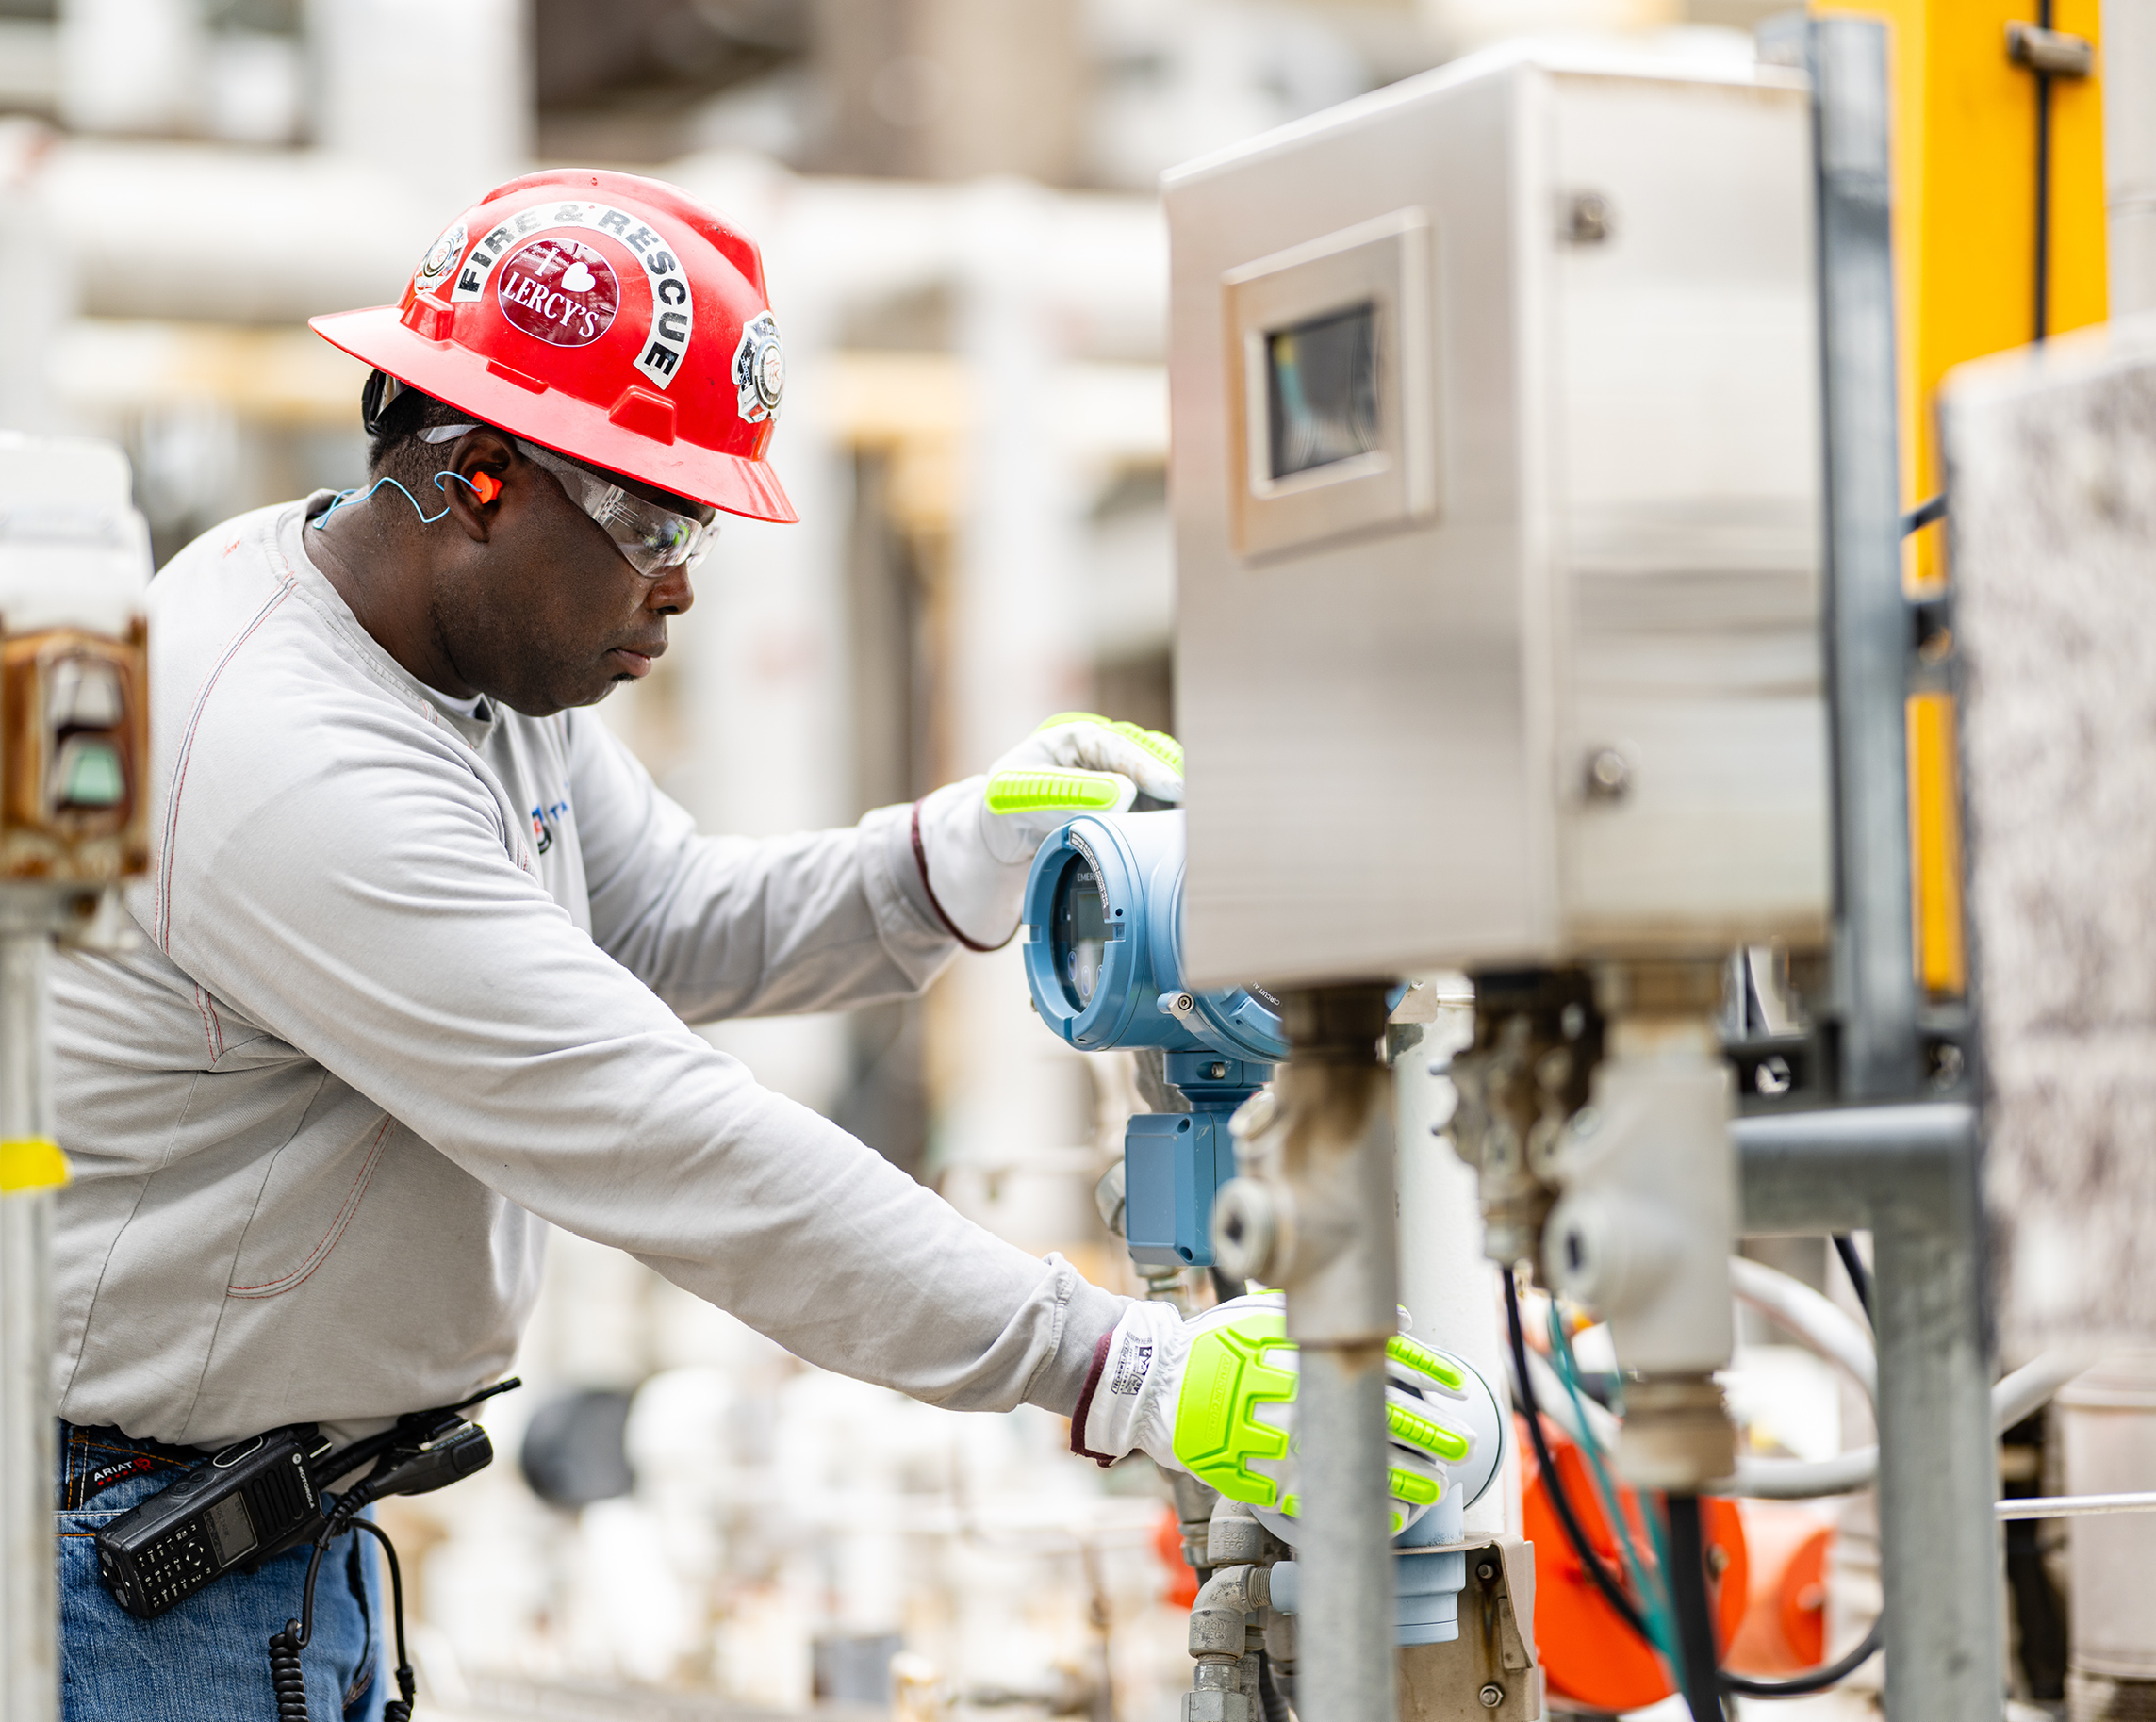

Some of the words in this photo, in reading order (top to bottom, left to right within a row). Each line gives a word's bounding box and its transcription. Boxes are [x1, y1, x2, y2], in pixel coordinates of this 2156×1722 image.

[533, 248, 559, 277] I
[458, 209, 542, 294] FIRE
[553, 204, 585, 224] &
[598, 208, 689, 378] RESCUE
[502, 271, 601, 340] LERCY'S
[94, 1461, 133, 1482] ARIAT
[297, 1466, 316, 1509] MOTOROLA
